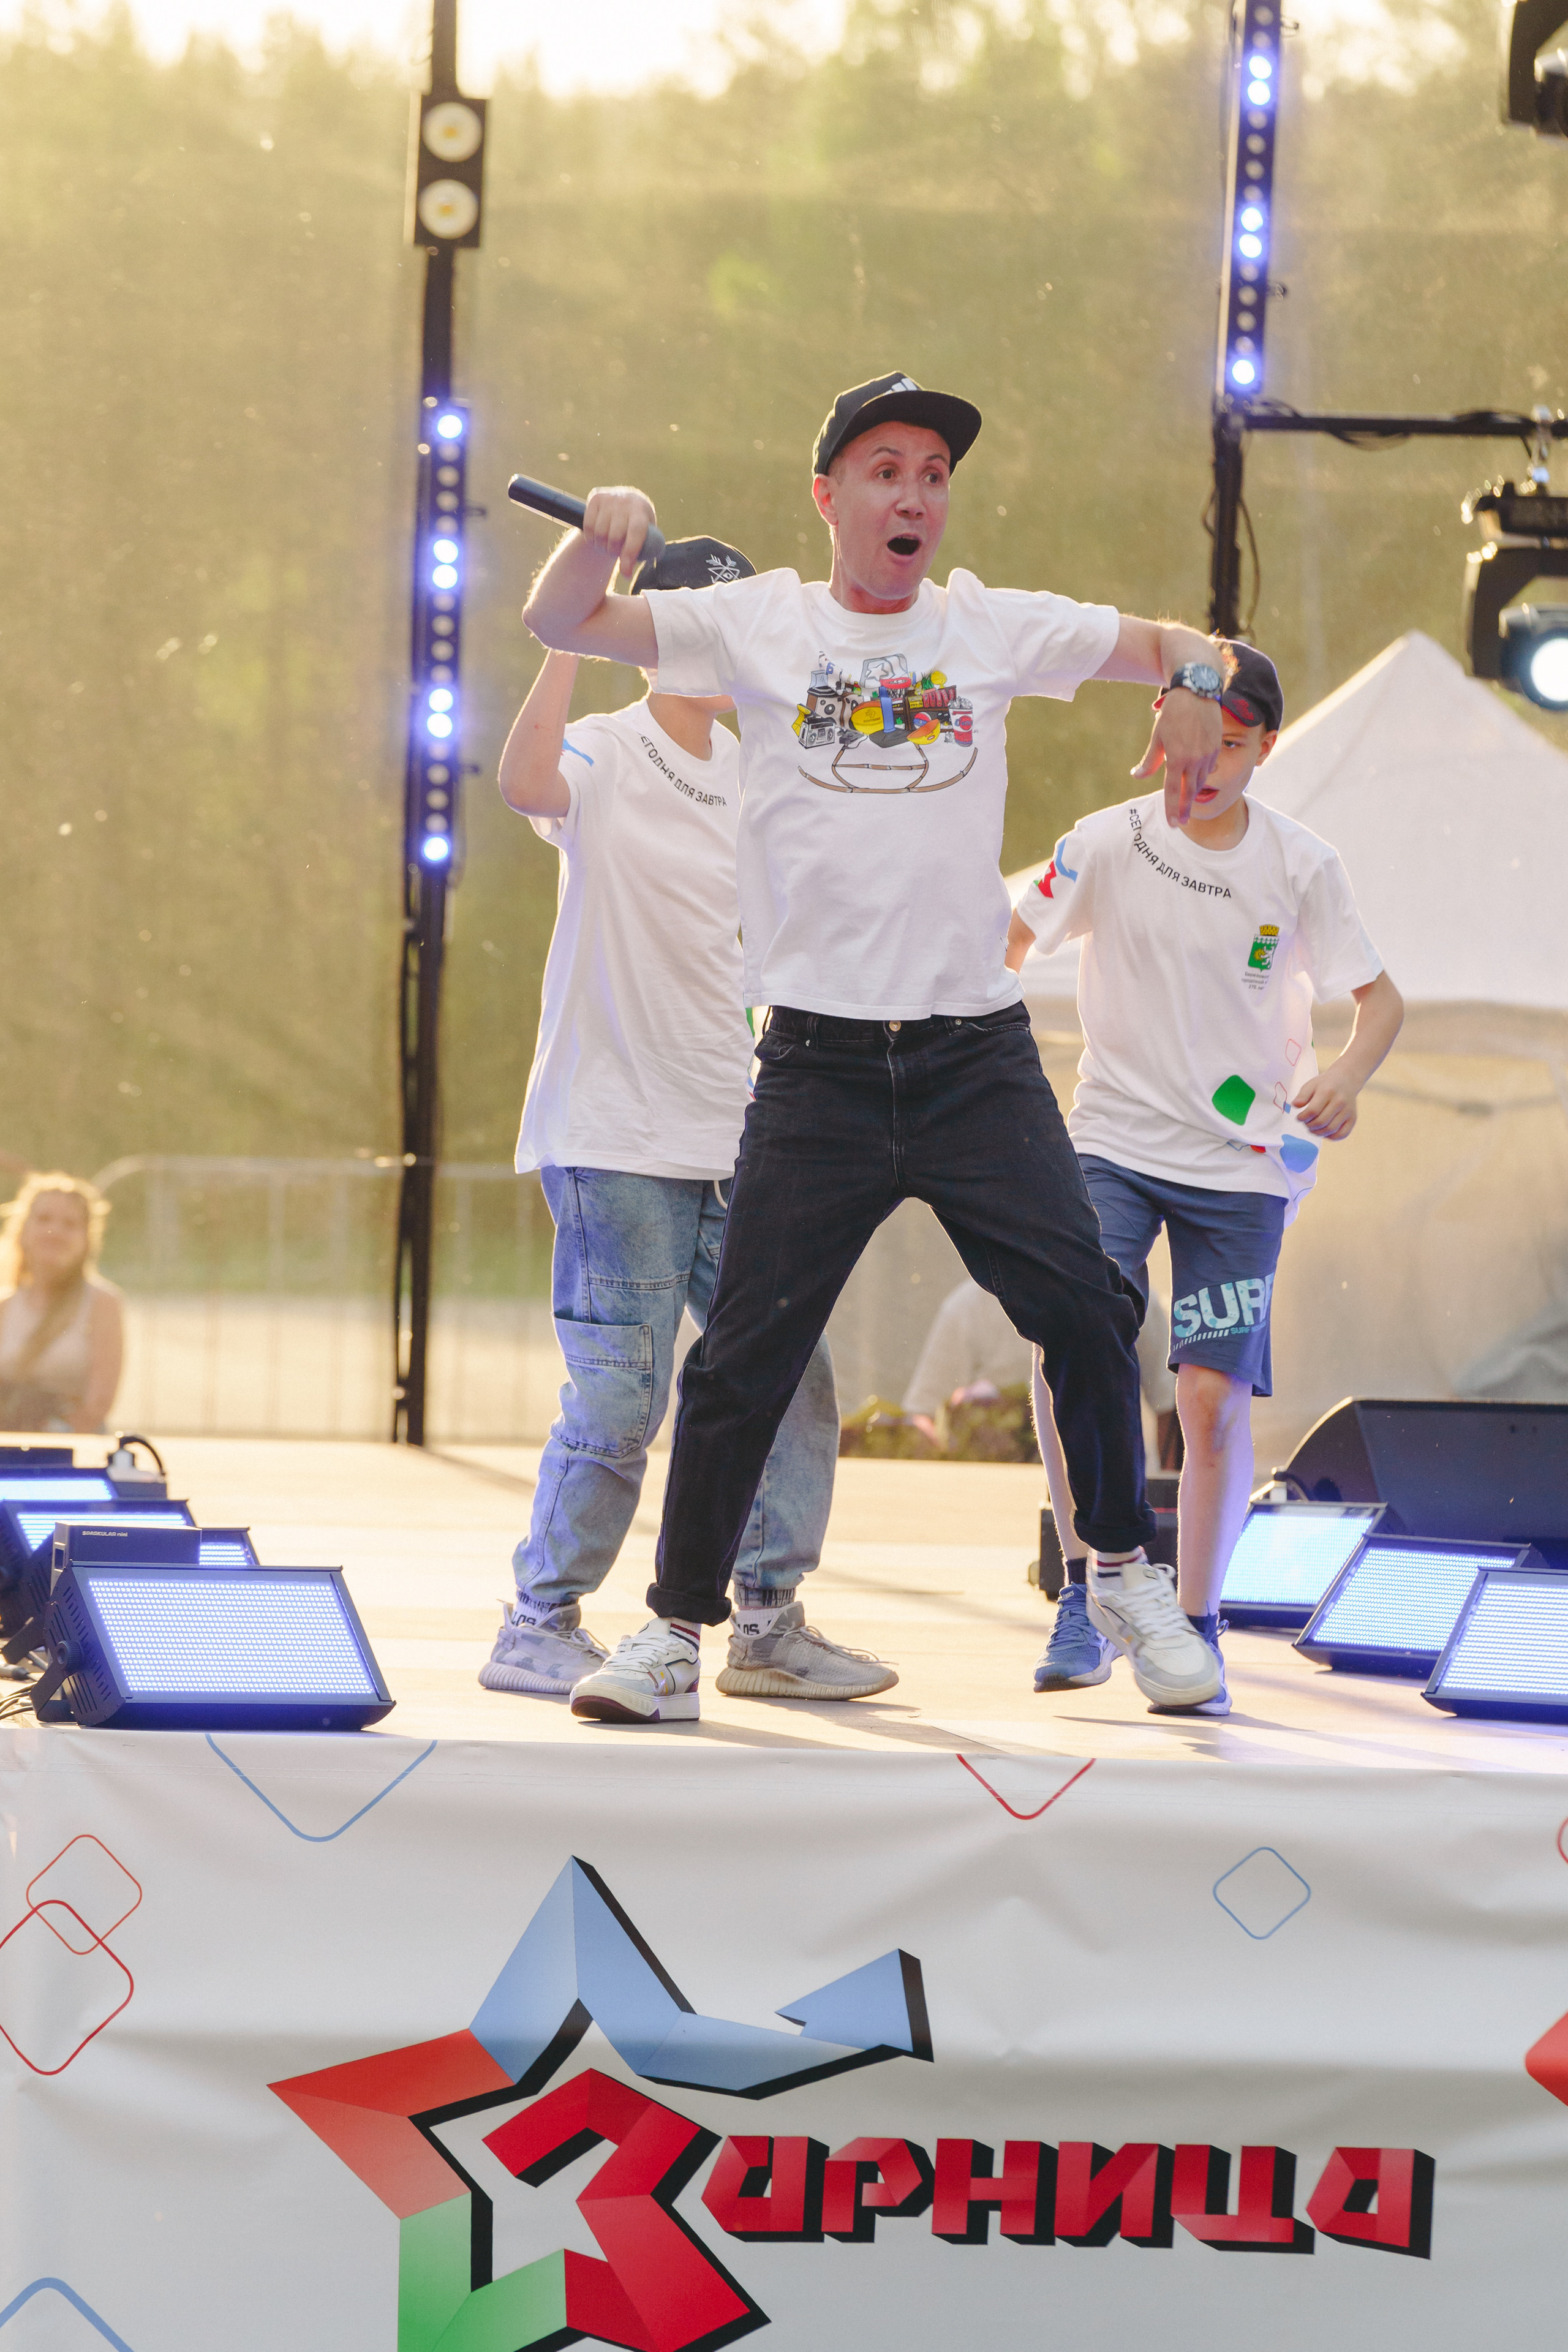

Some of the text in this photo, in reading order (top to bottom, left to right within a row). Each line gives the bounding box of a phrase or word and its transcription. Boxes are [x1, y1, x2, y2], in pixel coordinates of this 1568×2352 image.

[637, 732, 728, 807] ЕГОДНЯ ДЛЯ ЗАВТРА
[1129, 808, 1232, 899] #СЕГОДНЯ ДЛЯ ЗАВТРА
[1231, 1326, 1251, 1335] SURF
